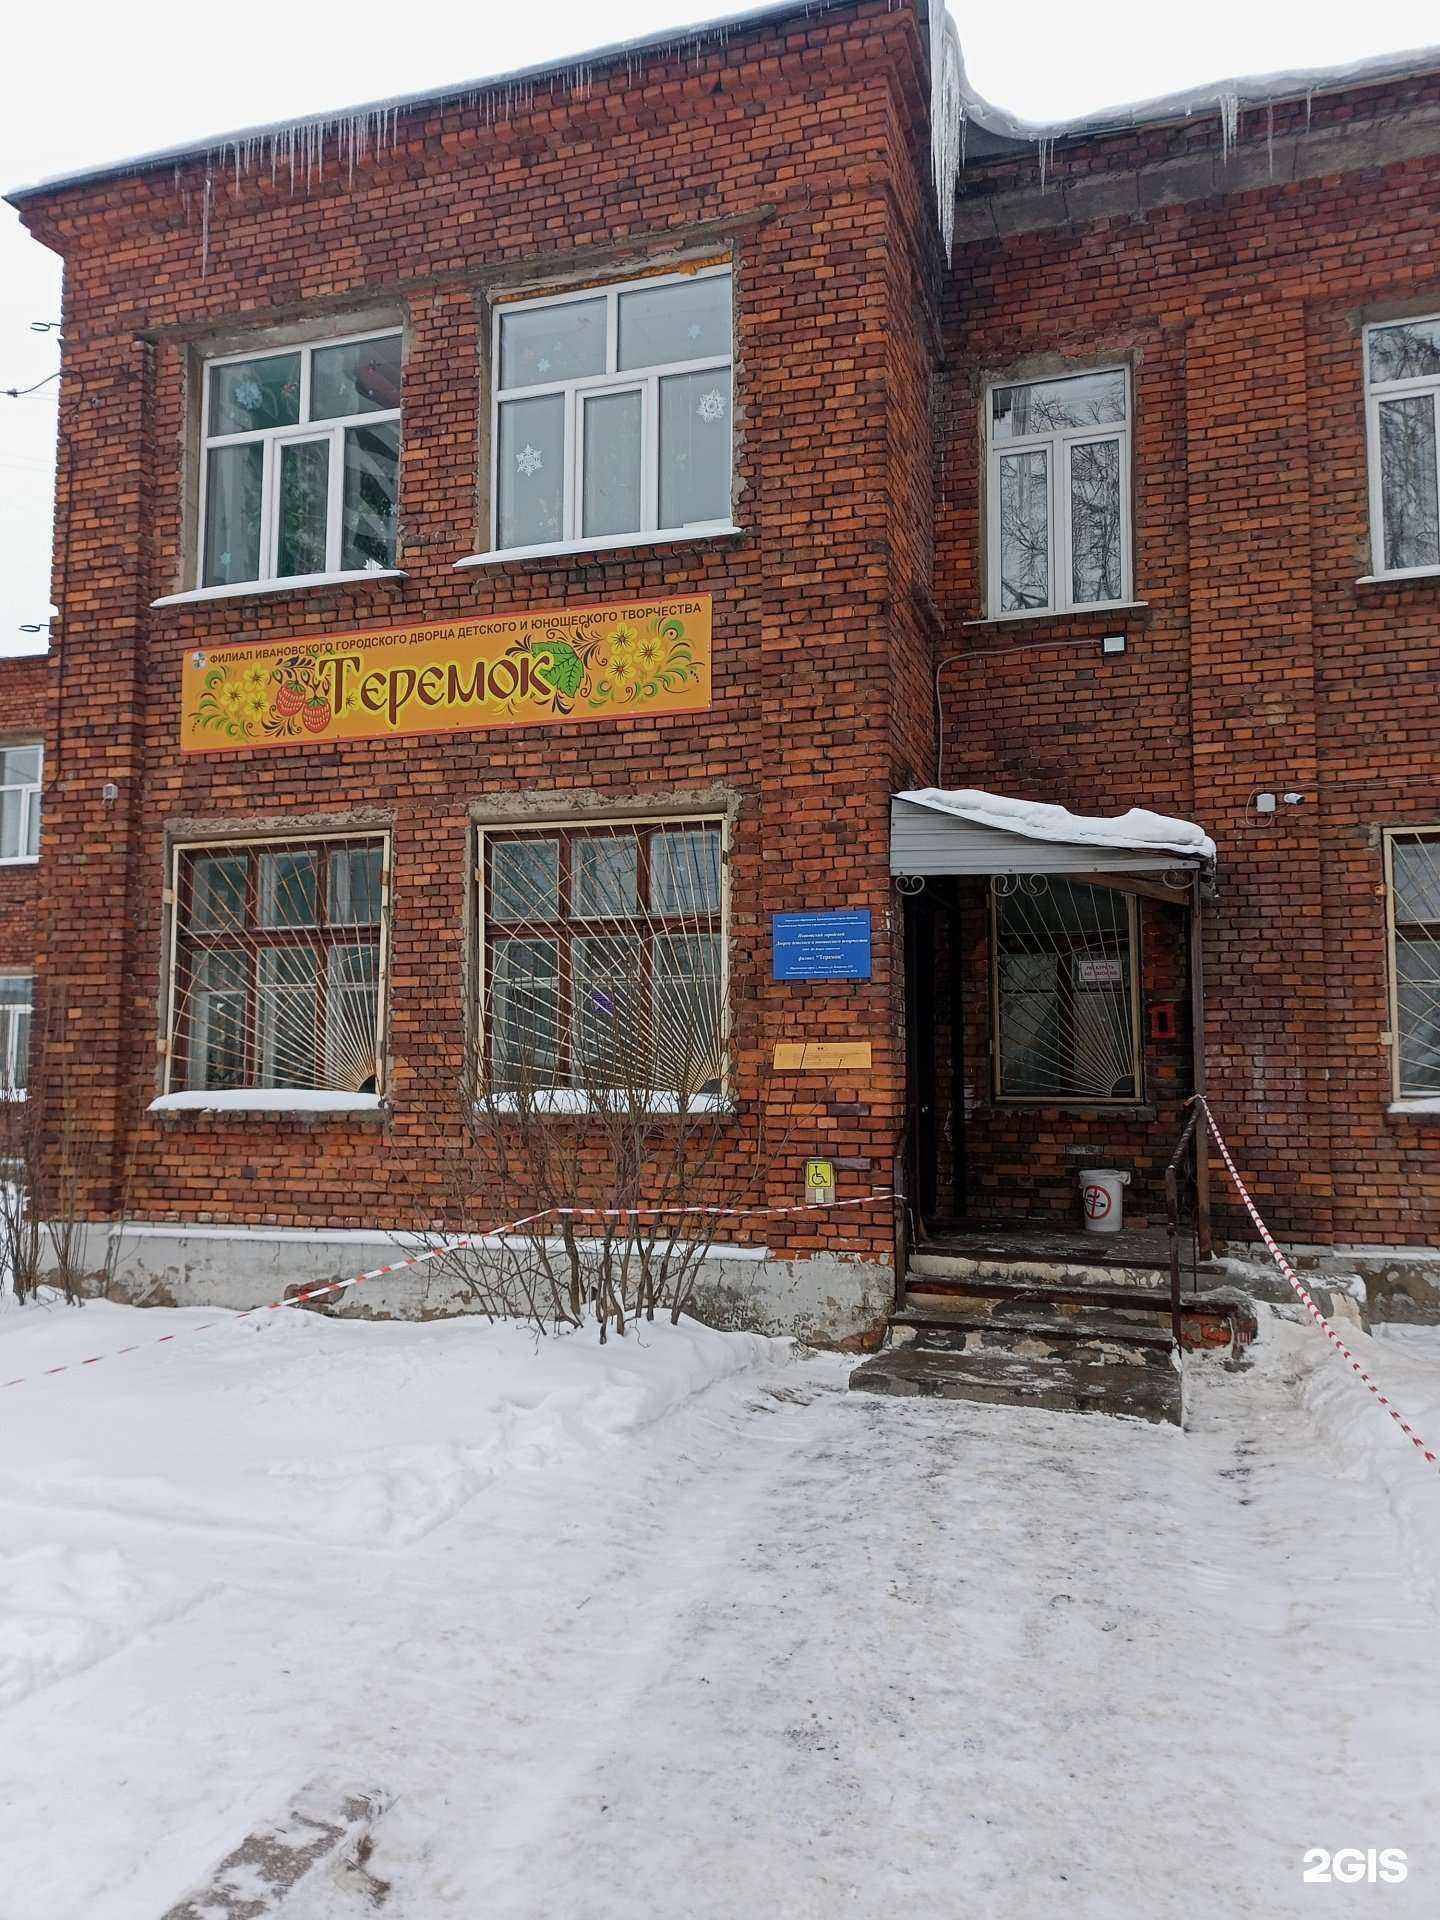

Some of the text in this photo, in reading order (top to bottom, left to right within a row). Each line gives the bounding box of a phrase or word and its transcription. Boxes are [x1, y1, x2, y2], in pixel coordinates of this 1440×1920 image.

[209, 602, 702, 664] ФИЛИАЛ ИВАНОВСКОГО ГОРОДСКОГО ДВОРЦА ДЕТСКОГО И ЮНОШЕСКОГО ТВОРЧЕСТВА
[318, 655, 551, 724] Теремок
